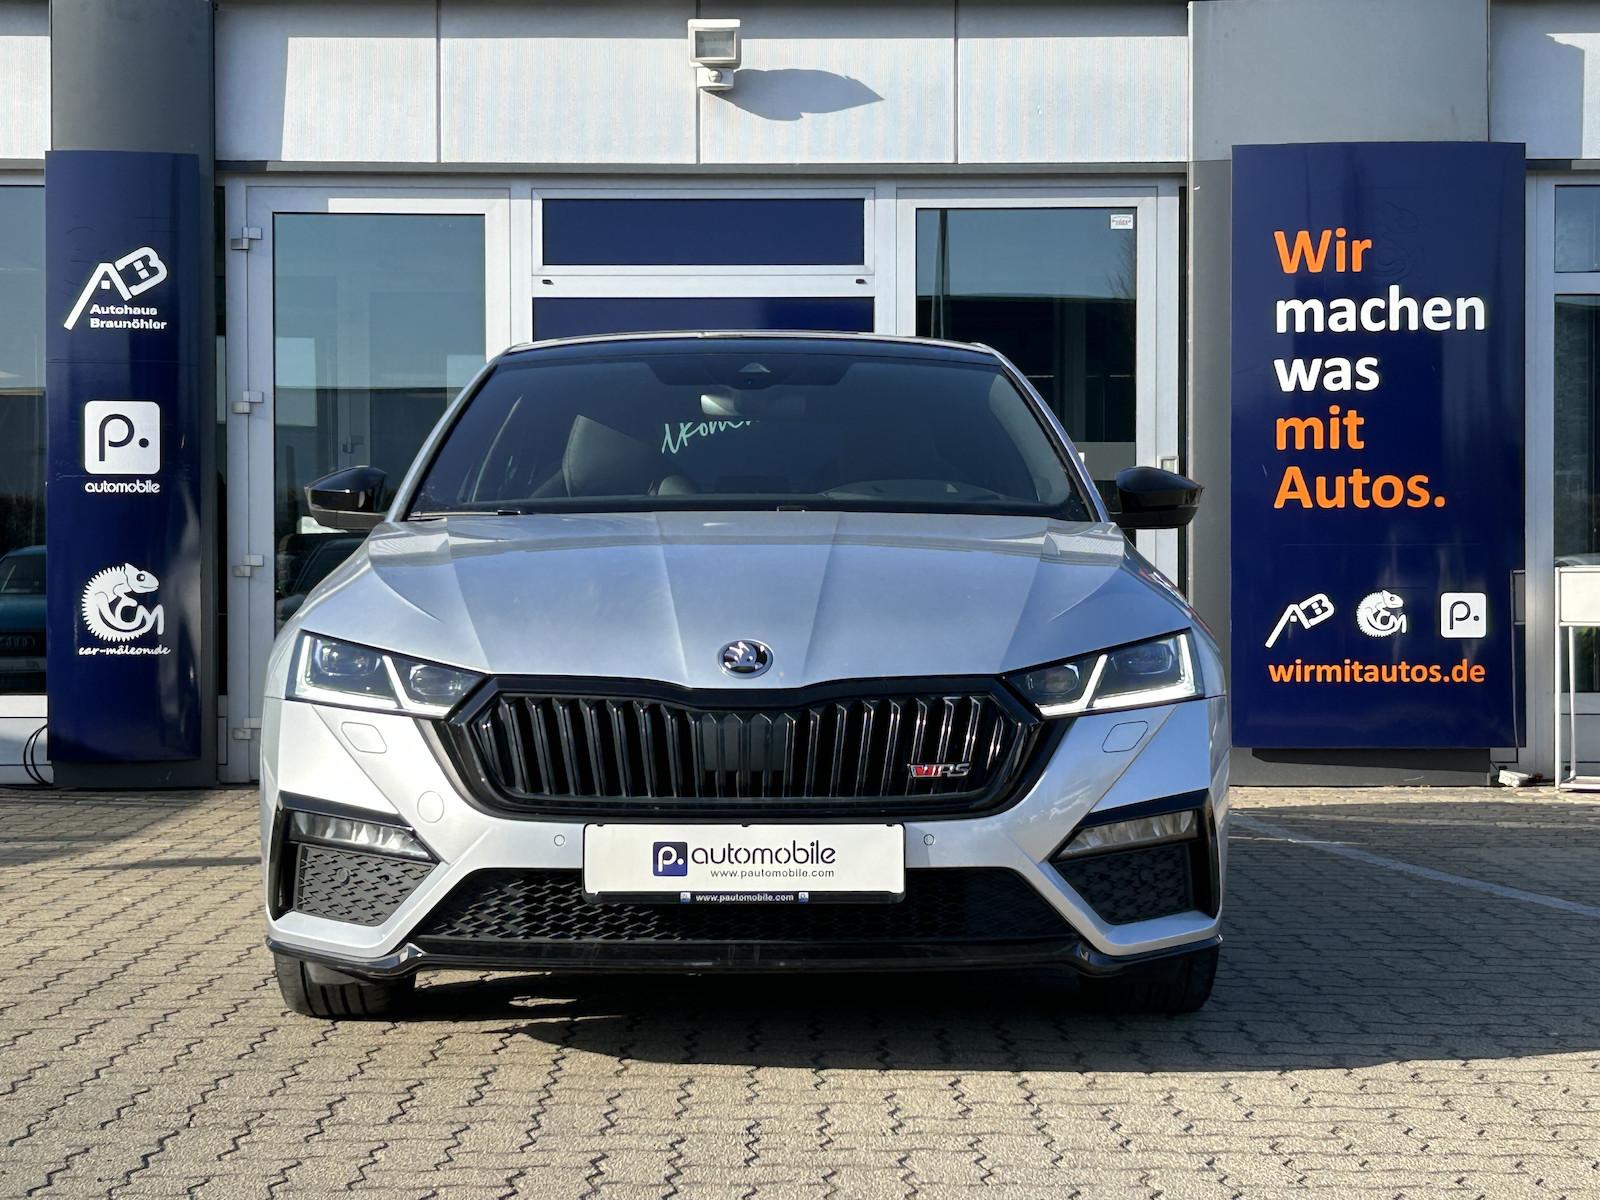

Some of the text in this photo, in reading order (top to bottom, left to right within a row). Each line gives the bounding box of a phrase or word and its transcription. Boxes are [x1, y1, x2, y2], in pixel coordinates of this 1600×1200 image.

[1274, 227, 1372, 273] Wir
[89, 303, 158, 315] Autohaus
[1276, 285, 1485, 333] machen
[89, 317, 168, 329] Braunöhler
[1274, 357, 1380, 392] was
[1276, 405, 1365, 450] mit
[84, 479, 161, 494] automobile
[1274, 466, 1445, 508] Autos.
[1268, 658, 1486, 683] wirmitautos.de
[691, 839, 836, 865] automobile
[710, 868, 835, 880] www.pautomobile.com
[695, 893, 794, 904] www.pautomobile.com
